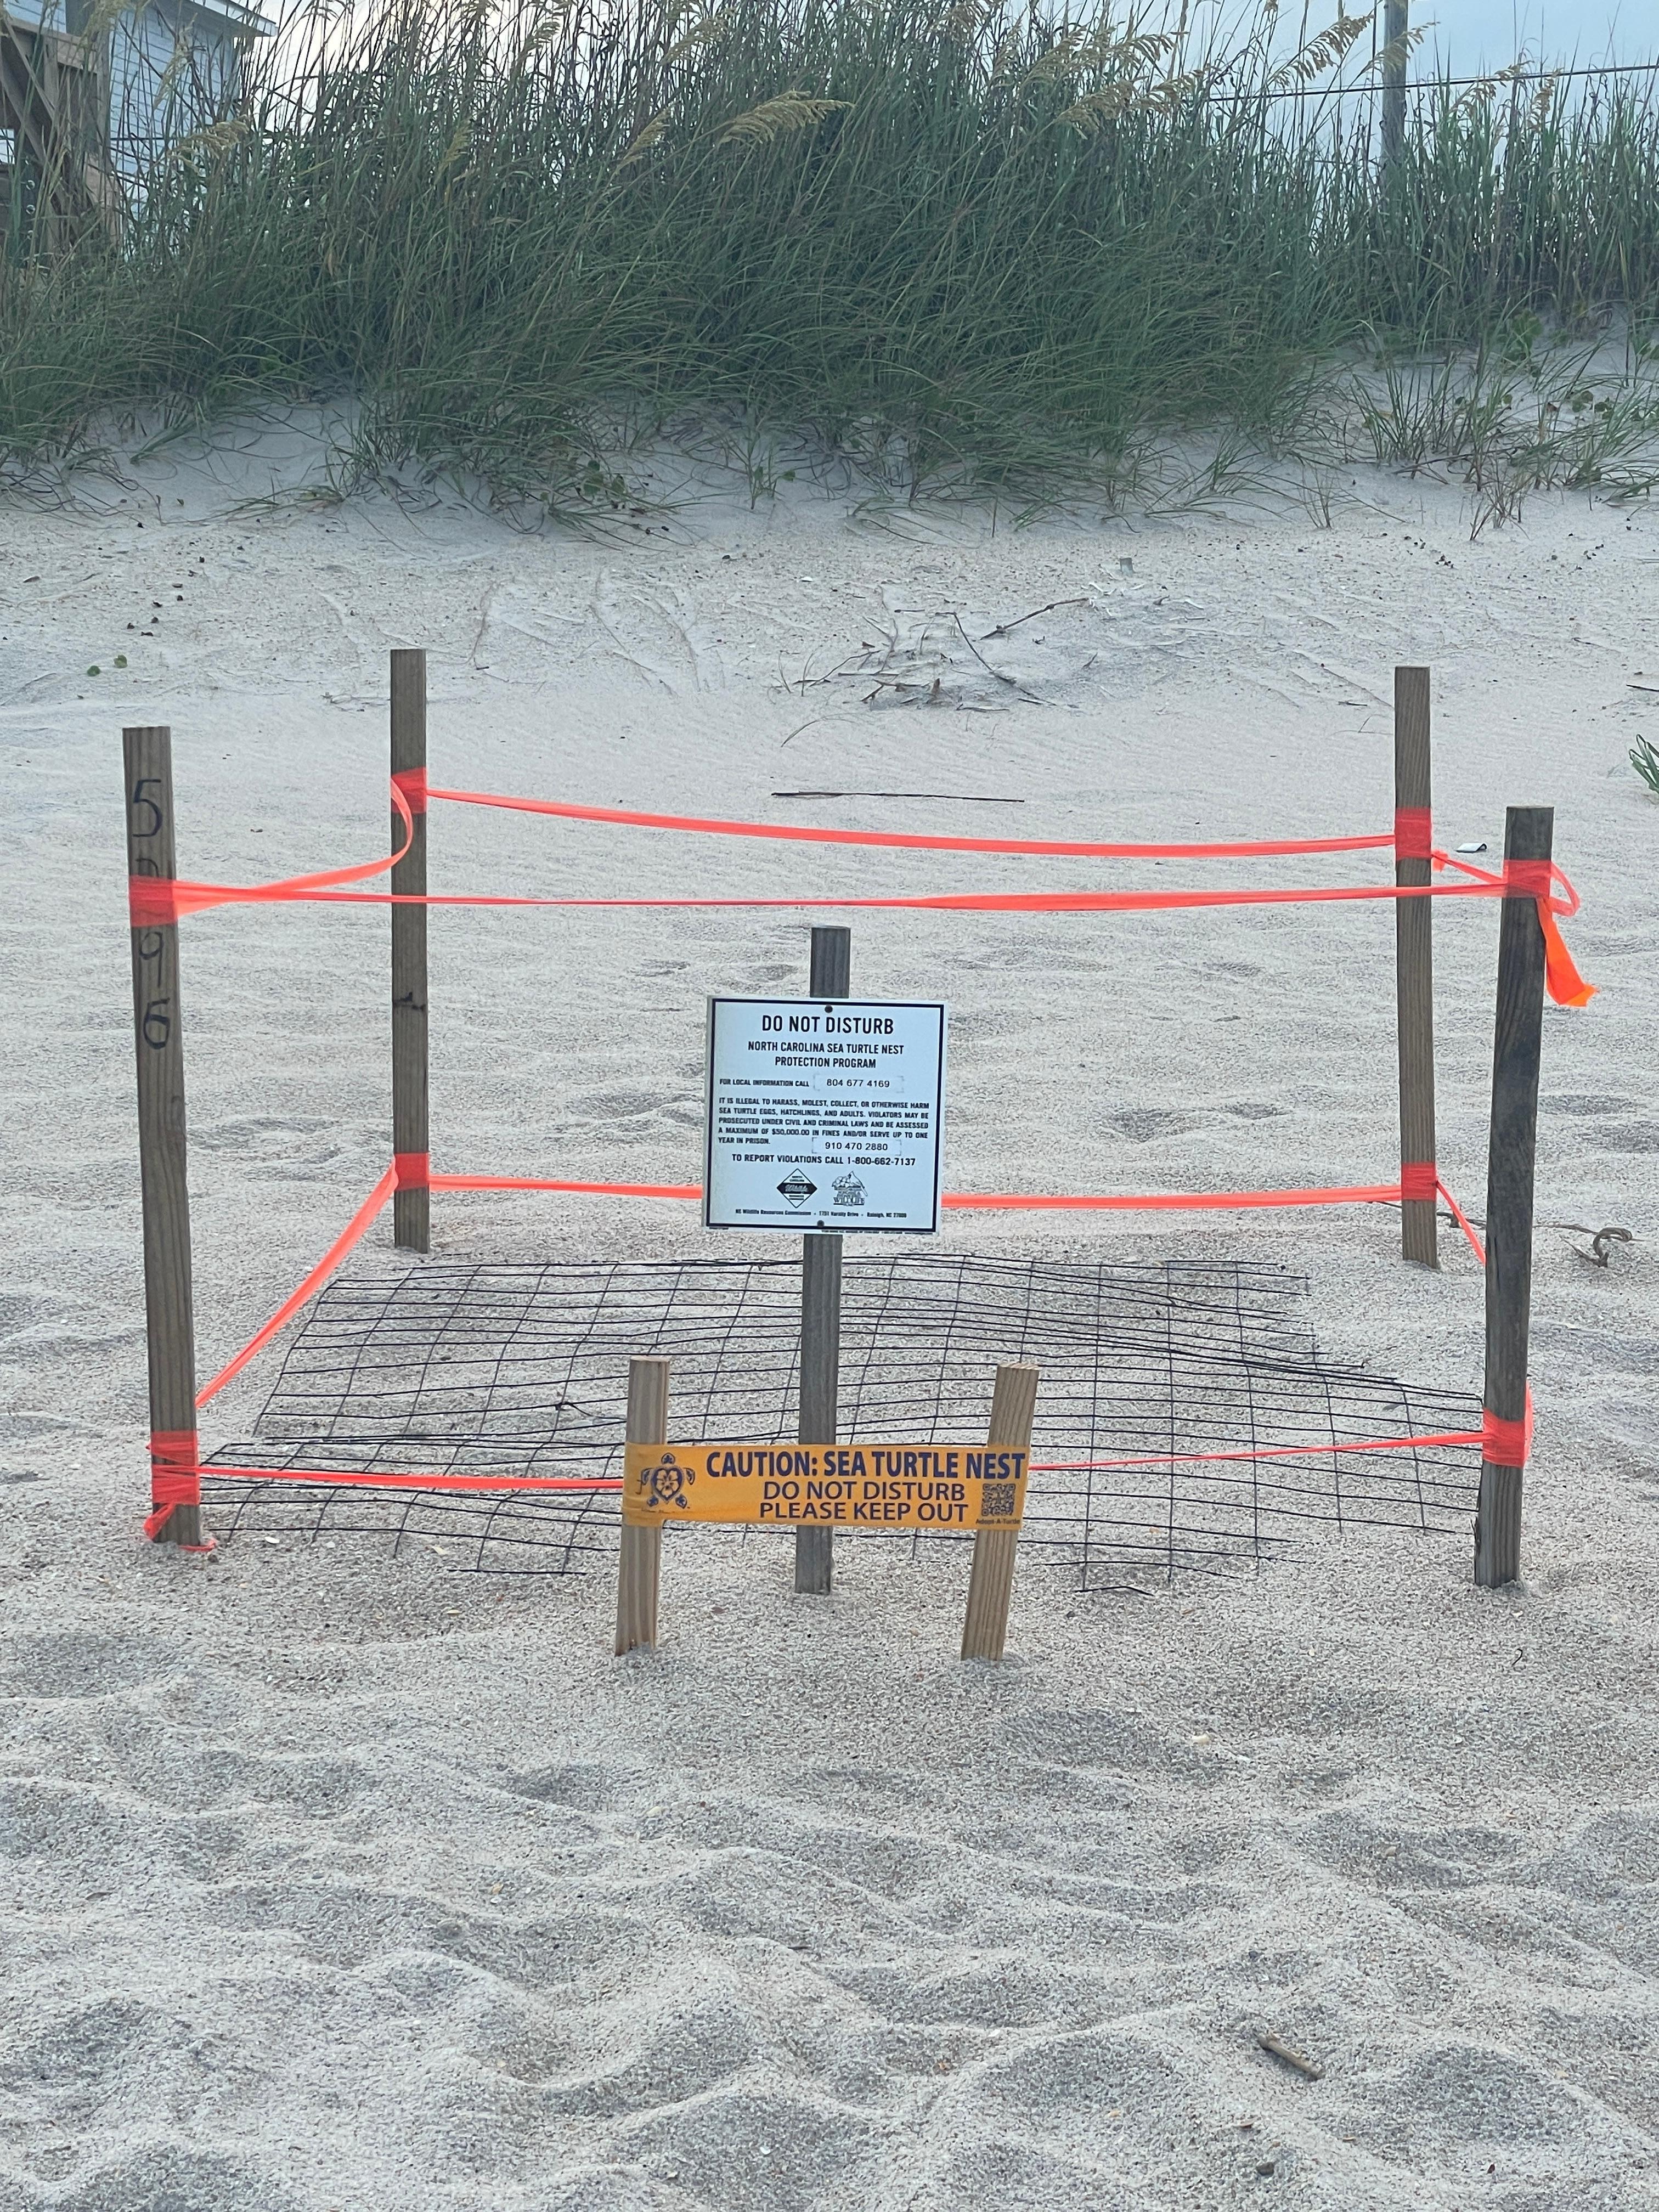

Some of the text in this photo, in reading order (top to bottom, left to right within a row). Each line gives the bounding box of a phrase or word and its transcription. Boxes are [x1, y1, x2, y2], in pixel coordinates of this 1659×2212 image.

[762, 1015, 893, 1034] DO NOT DISTURB
[748, 1041, 904, 1054] NORTH CAROLINA SEA TURTLE NEST
[775, 1056, 876, 1068] PROTECTION PROGRAM
[744, 1154, 774, 1162] REPORT
[777, 1155, 822, 1163] VIOLATIONS
[848, 1156, 915, 1166] 1-800-662-7137
[707, 1451, 1025, 1480] CAUTION: SEA TURTLE NEST
[764, 1481, 964, 1500] DO NOT DISTURB
[760, 1502, 968, 1522] PLEASE KEEP OUT
